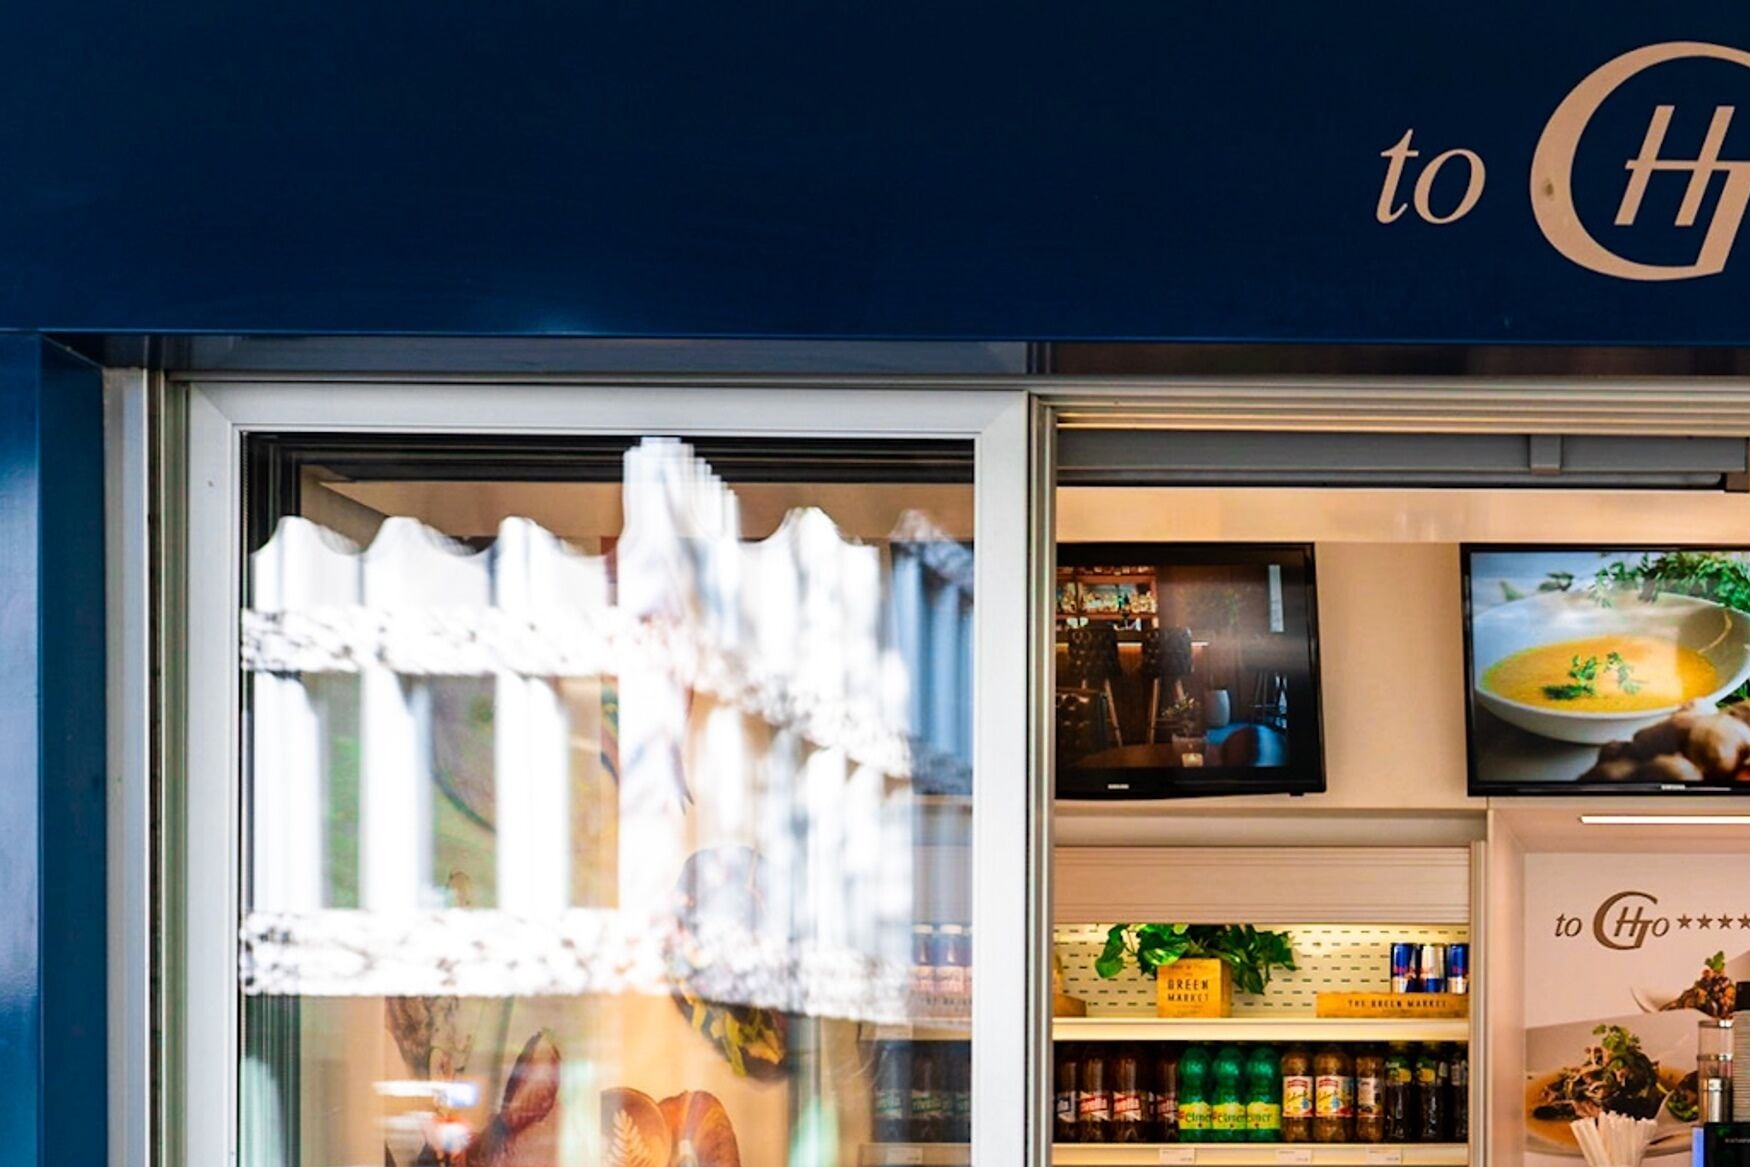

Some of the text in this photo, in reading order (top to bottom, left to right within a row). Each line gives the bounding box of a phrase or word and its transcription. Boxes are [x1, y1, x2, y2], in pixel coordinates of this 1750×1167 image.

[1375, 128, 1487, 226] to
[1555, 913, 1582, 937] to
[1167, 979, 1208, 990] GREEN
[1167, 993, 1208, 1002] MARKET
